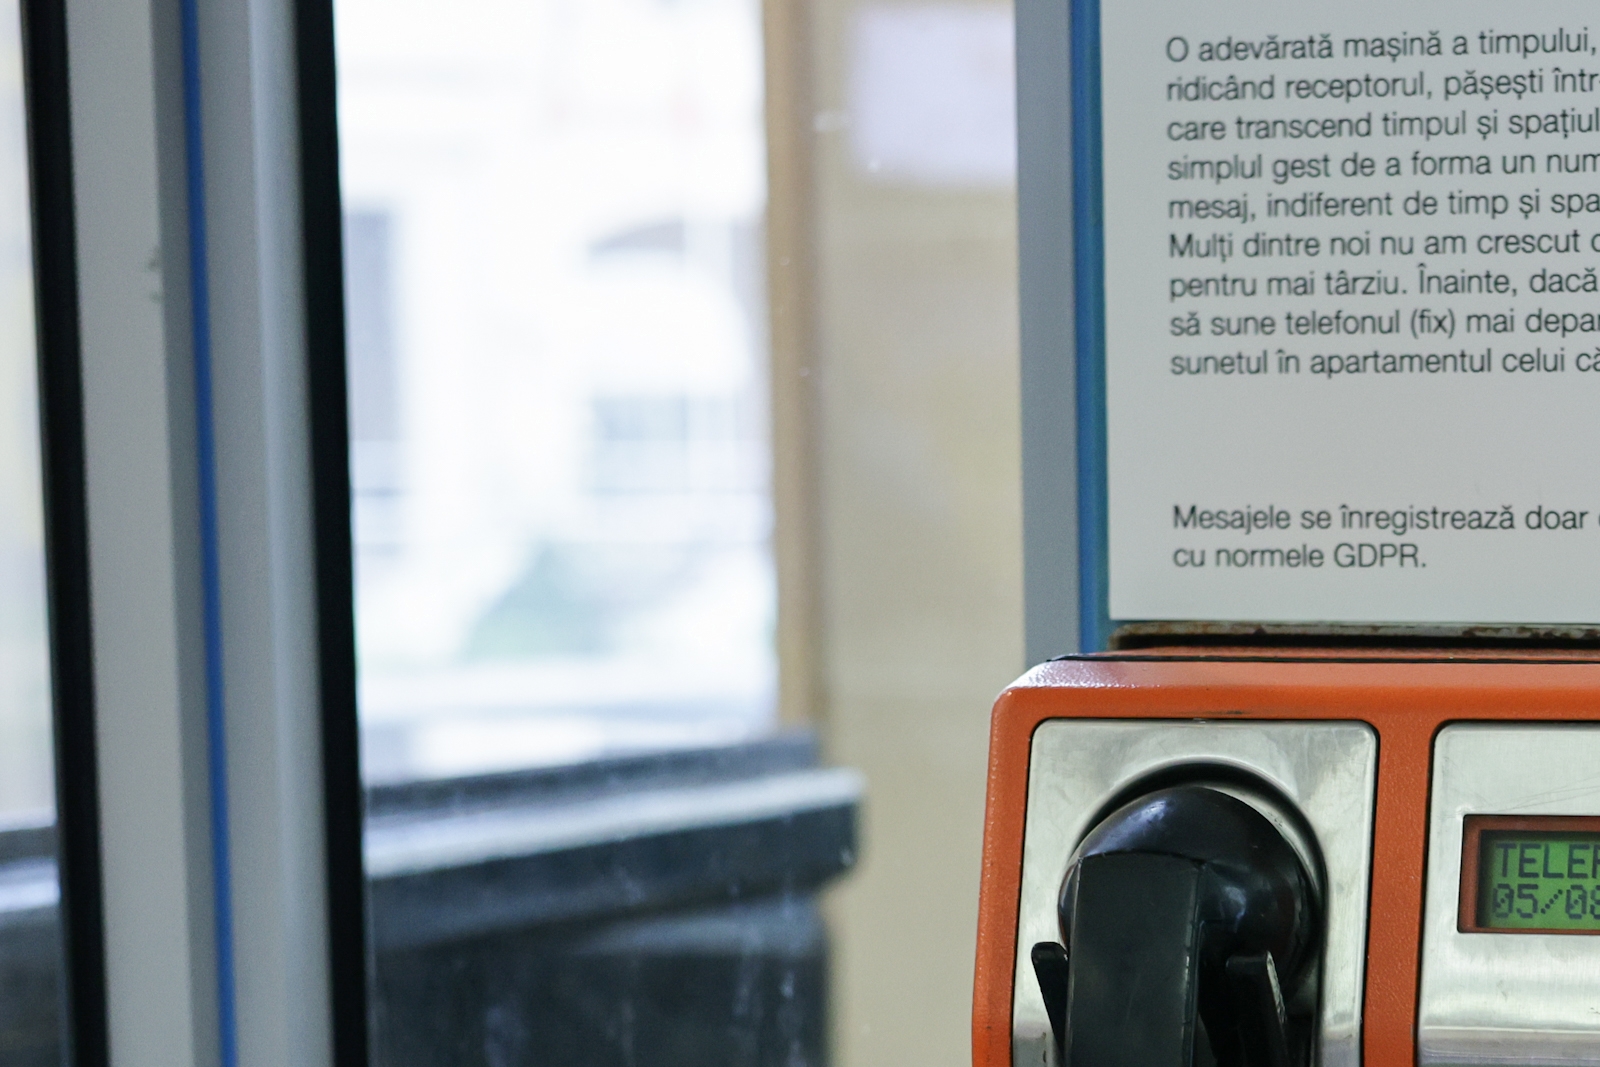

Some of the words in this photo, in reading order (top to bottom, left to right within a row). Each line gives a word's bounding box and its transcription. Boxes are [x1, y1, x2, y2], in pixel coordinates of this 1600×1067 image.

[1165, 35, 1190, 63] O
[1197, 32, 1335, 63] adevărată
[1343, 29, 1444, 64] mașină
[1451, 34, 1470, 56] a
[1477, 26, 1597, 60] timpului,
[1166, 74, 1276, 102] ridicând
[1285, 70, 1433, 104] receptorul,
[1443, 67, 1544, 102] pășești
[1166, 120, 1227, 142] care
[1234, 111, 1373, 140] transcend
[1381, 109, 1467, 142] timpul
[1476, 108, 1499, 142] și
[1167, 153, 1263, 186] simplul
[1271, 153, 1332, 186] gest
[1340, 151, 1376, 178] de
[1384, 156, 1403, 178] a
[1410, 149, 1493, 177] forma
[1501, 153, 1536, 175] un
[1167, 192, 1257, 225] mesaj,
[1266, 191, 1394, 218] indiferent
[1402, 189, 1439, 217] de
[1446, 189, 1510, 221] timp
[1518, 187, 1541, 221] și
[1168, 232, 1234, 264] Mulți
[1242, 231, 1321, 258] dintre
[1329, 229, 1371, 257] noi
[1379, 235, 1415, 256] nu
[1423, 234, 1467, 256] am
[1476, 228, 1582, 255] crescut
[1169, 273, 1258, 304] pentru
[1266, 270, 1315, 297] mai
[1323, 269, 1408, 297] târziu.
[1416, 261, 1518, 298] Înainte,
[1528, 266, 1600, 294] dacă
[1169, 311, 1202, 337] să
[1210, 315, 1277, 337] sune
[1284, 308, 1401, 336] telefonul
[1409, 307, 1456, 340] (fix)
[1465, 307, 1515, 334] mai
[1169, 348, 1269, 376] sunetul
[1274, 347, 1301, 375] în
[1309, 347, 1493, 380] apartamentul
[1501, 346, 1566, 374] celui
[1172, 503, 1292, 536] Mesajele
[1299, 509, 1333, 530] se
[1338, 503, 1517, 537] înregistrează
[1524, 504, 1590, 531] doar
[1171, 547, 1206, 568] cu
[1214, 543, 1325, 569] normele
[1332, 541, 1427, 569] GDPR.
